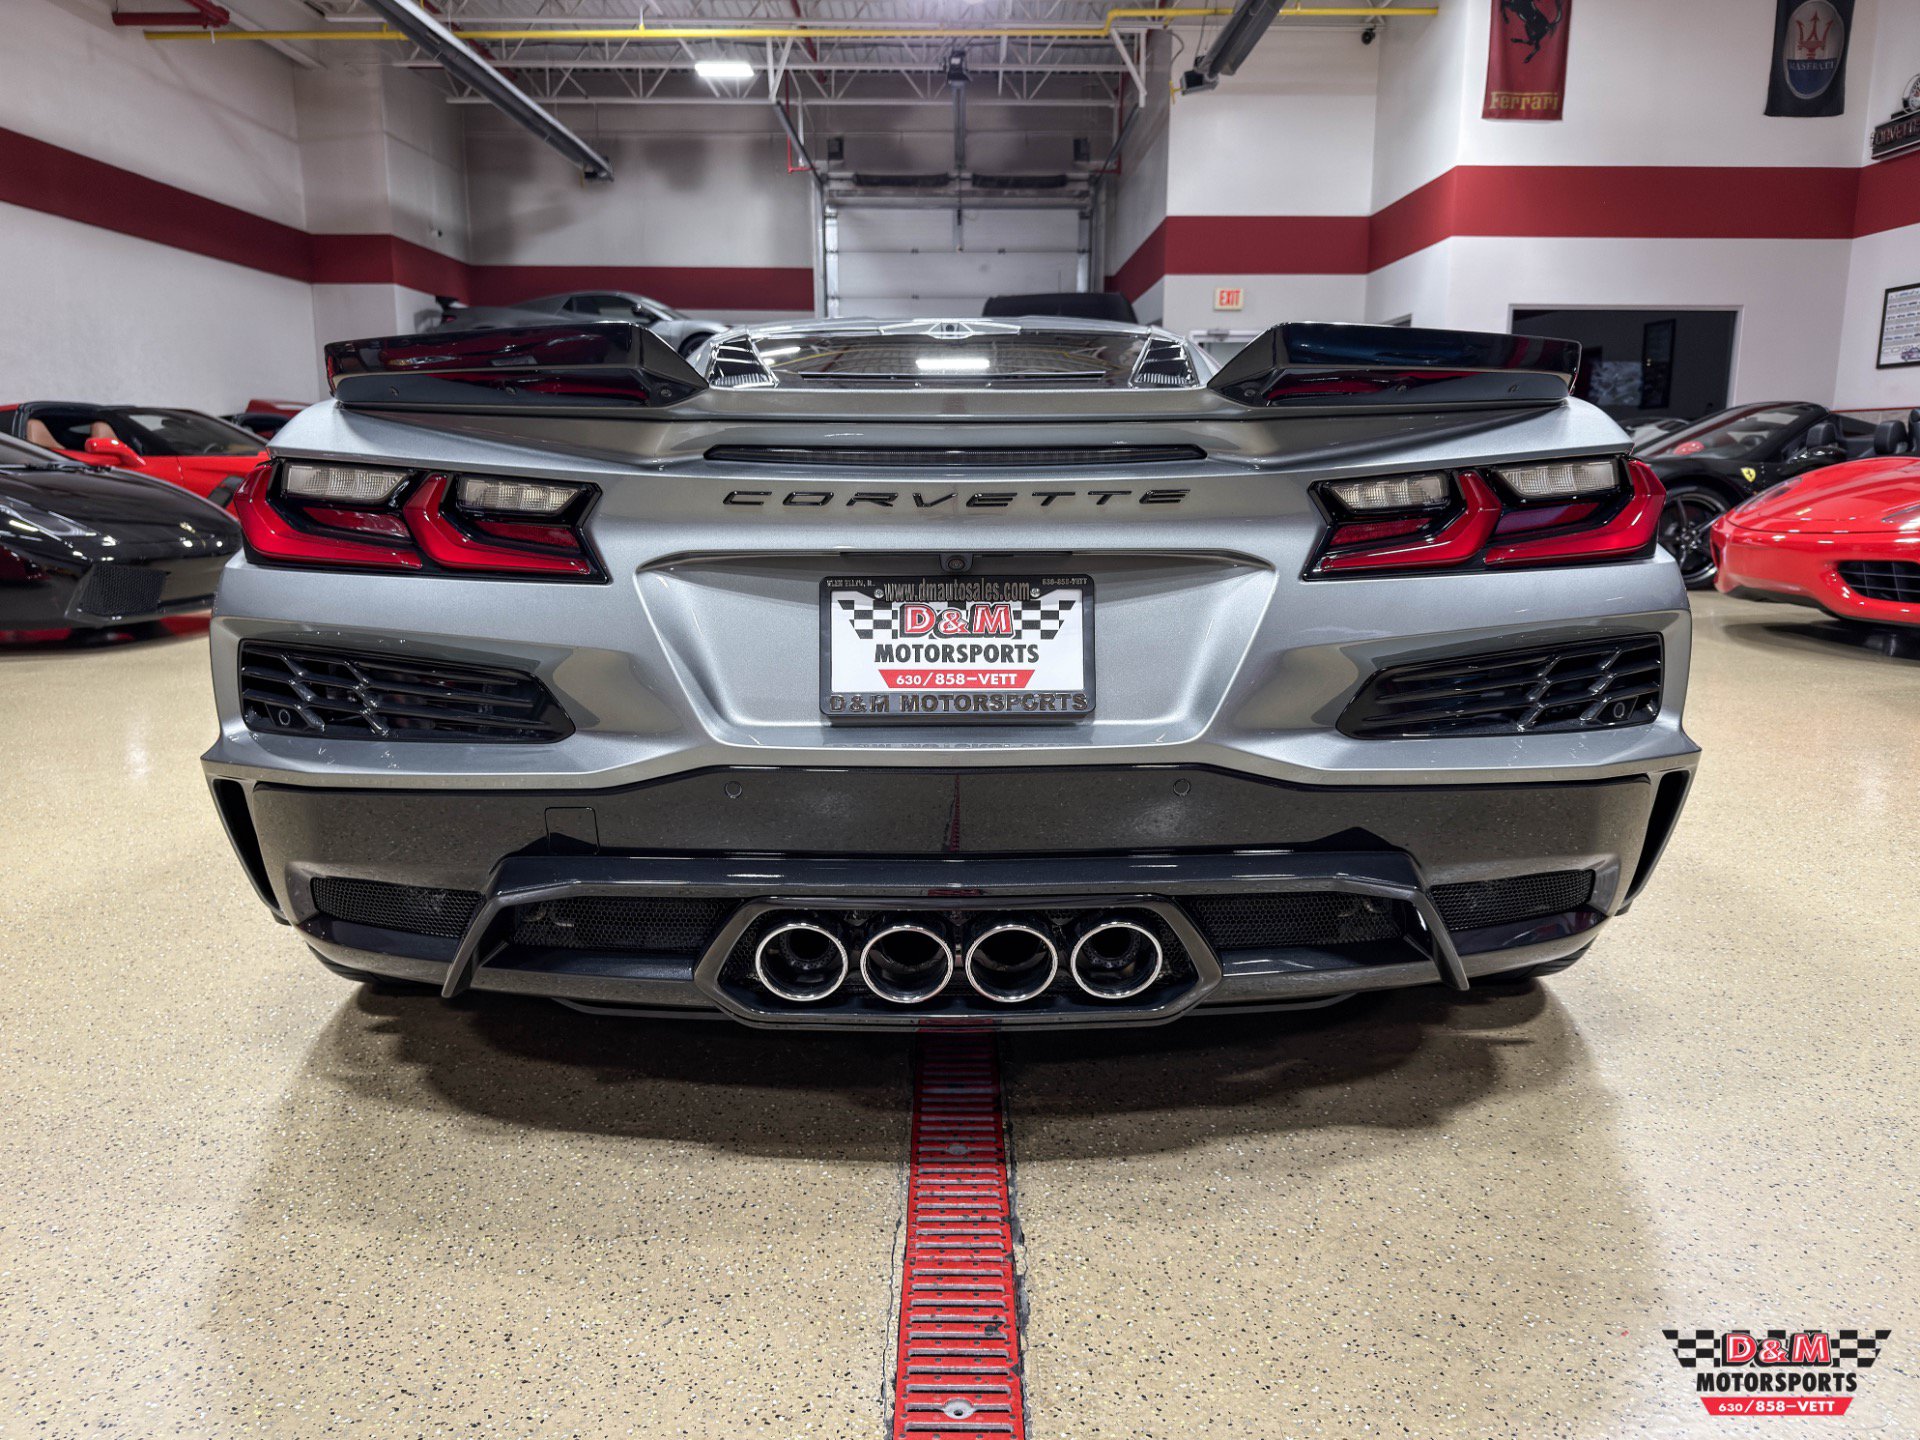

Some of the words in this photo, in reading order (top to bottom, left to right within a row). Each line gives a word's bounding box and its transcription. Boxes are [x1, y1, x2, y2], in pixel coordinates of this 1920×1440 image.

[1489, 91, 1558, 110] Ferrari
[1219, 289, 1241, 306] EXIT
[722, 488, 1191, 507] CORVETTE
[884, 578, 1030, 601] www.dmautosales.com
[901, 604, 1014, 637] D&M
[874, 644, 1039, 663] MOTORSPORTS
[896, 673, 1018, 686] 630/858-VETT
[830, 694, 890, 712] D&M
[900, 692, 1088, 713] MOTORSPORTS
